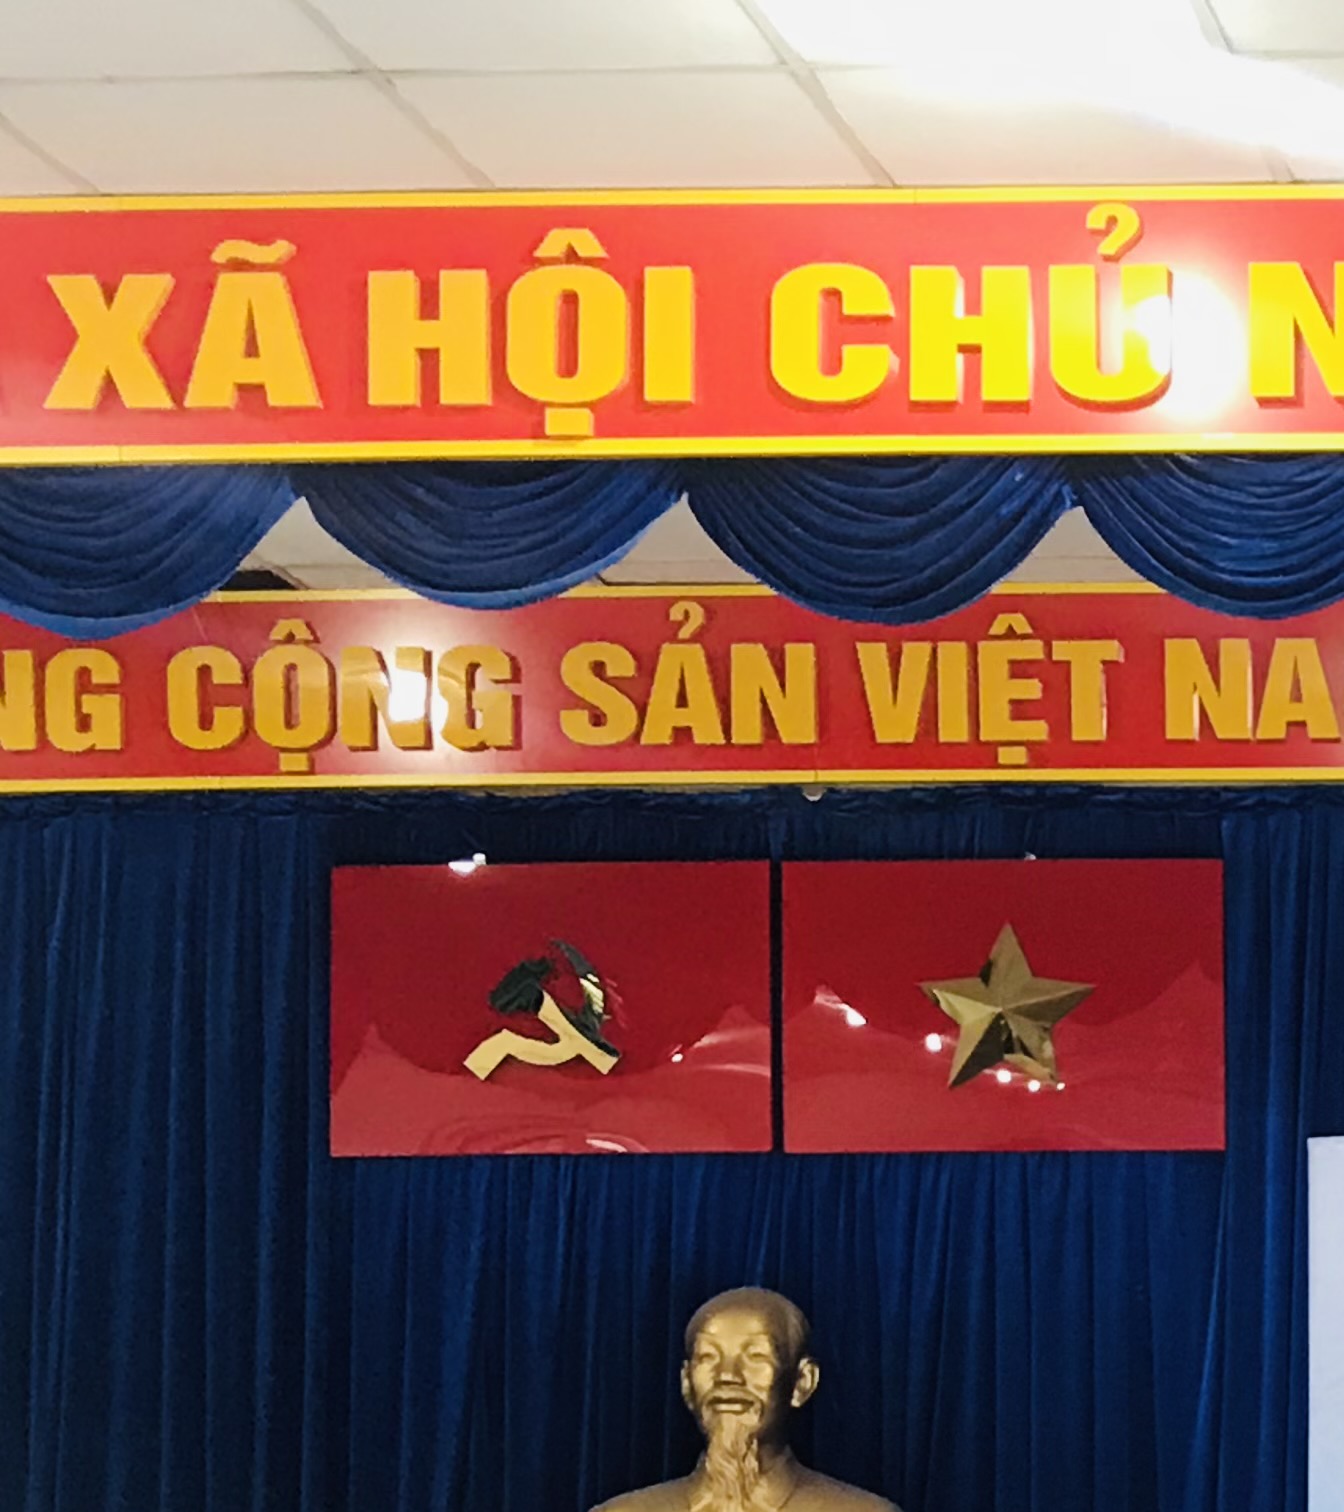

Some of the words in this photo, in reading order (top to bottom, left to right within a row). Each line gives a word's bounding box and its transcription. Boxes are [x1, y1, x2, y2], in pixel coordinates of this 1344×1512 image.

[42, 240, 325, 410] XÃ
[366, 228, 695, 437] HỘI
[770, 202, 1176, 404] CHỦ
[166, 618, 521, 772] CỘNG
[560, 601, 817, 749] SẢN
[856, 612, 1127, 765] VIỆT
